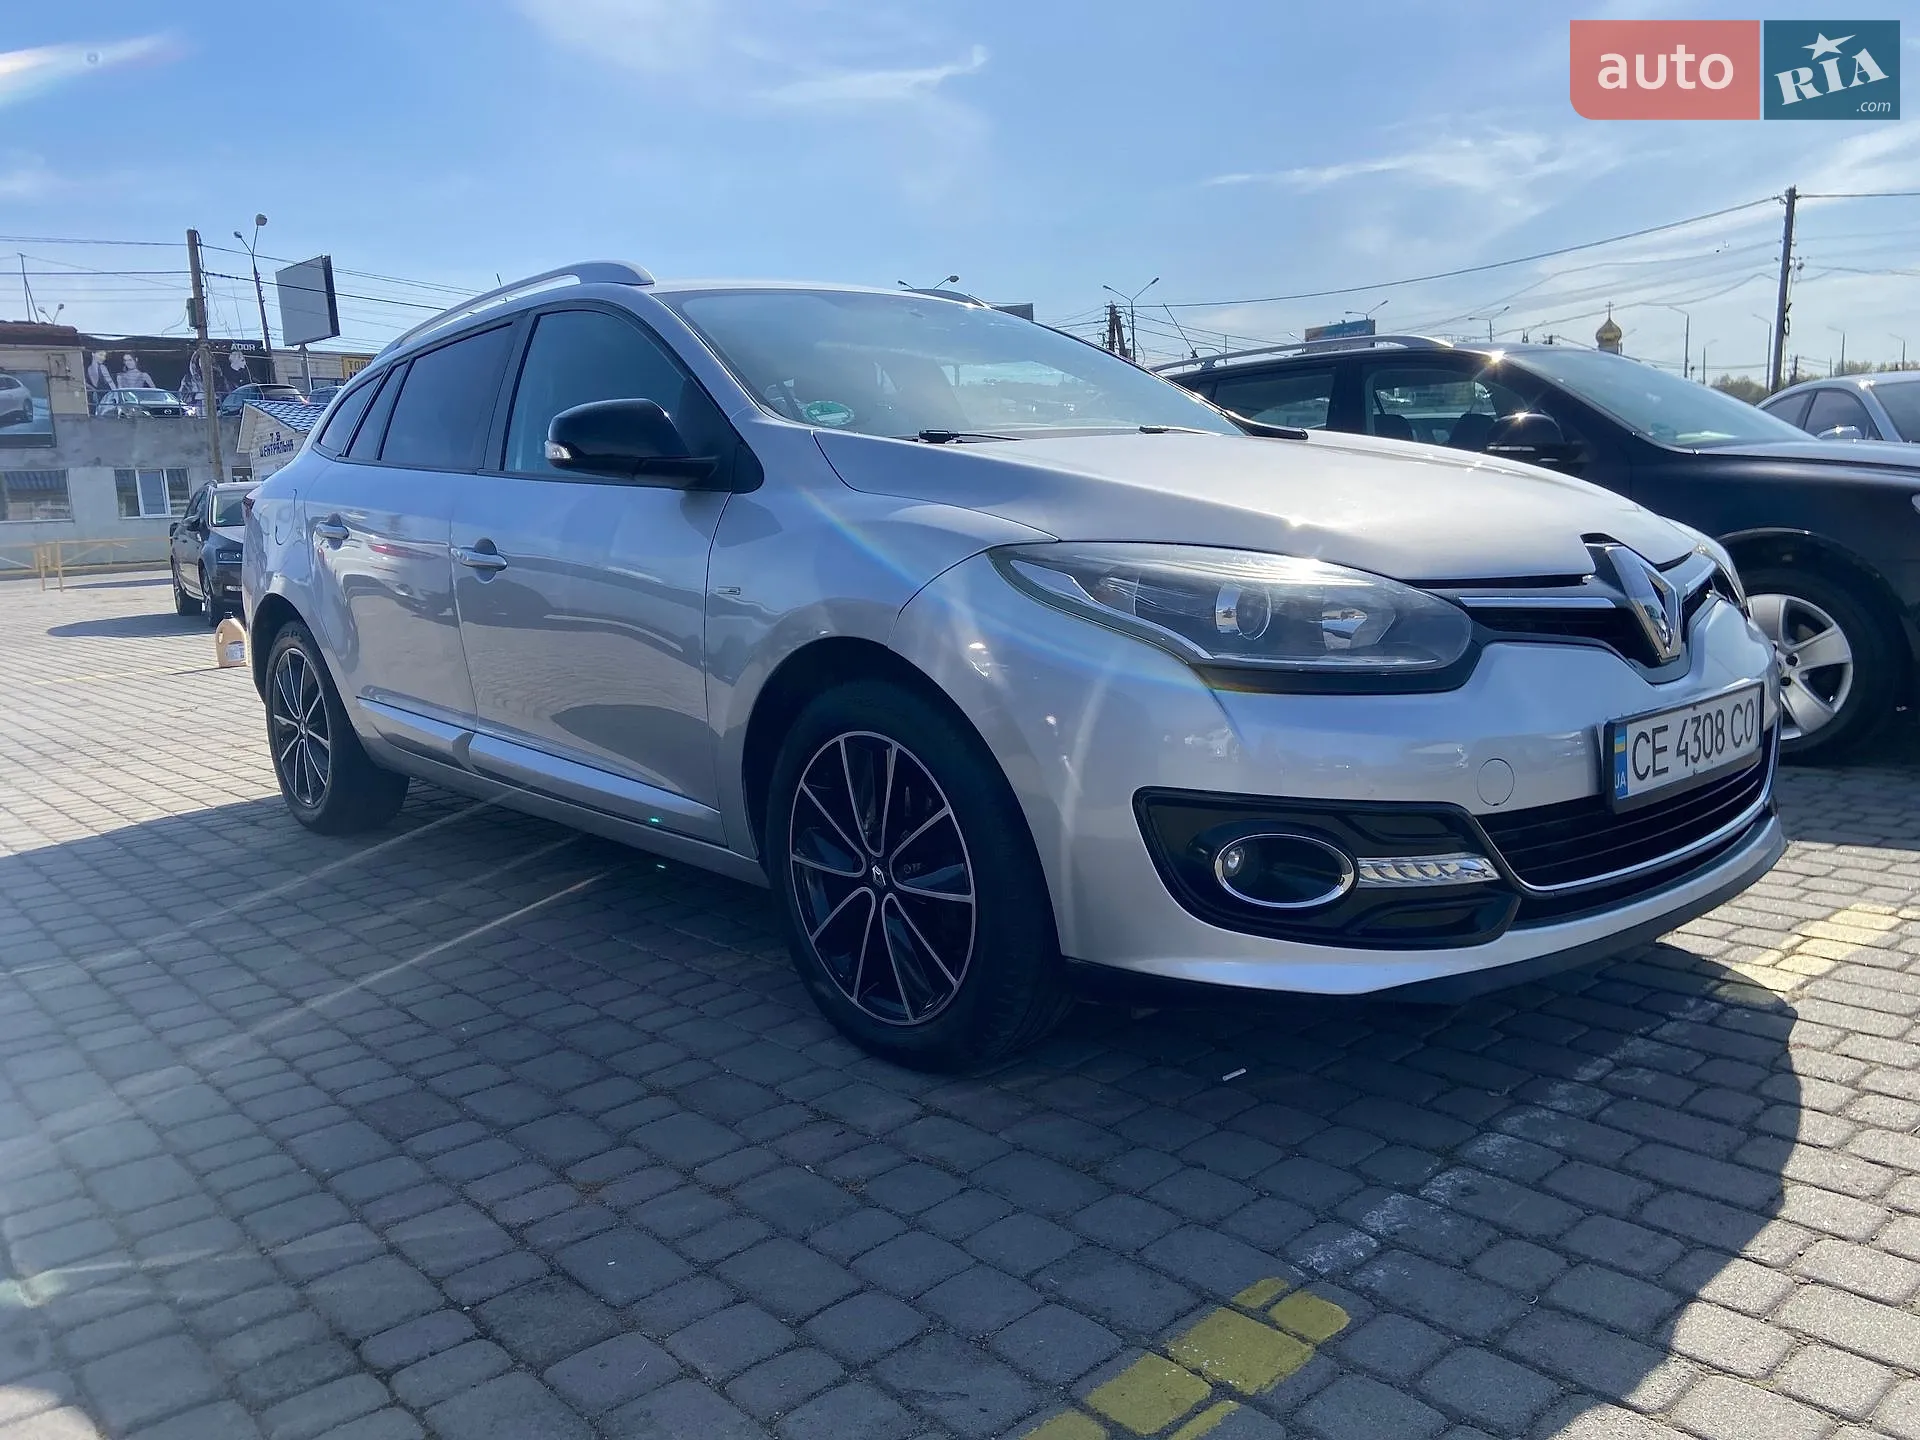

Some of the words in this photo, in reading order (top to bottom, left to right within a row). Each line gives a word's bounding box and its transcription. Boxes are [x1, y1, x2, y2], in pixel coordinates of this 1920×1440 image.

[1632, 724, 1669, 781] CE
[1676, 708, 1725, 767] 4308
[1615, 771, 1628, 789] UA
